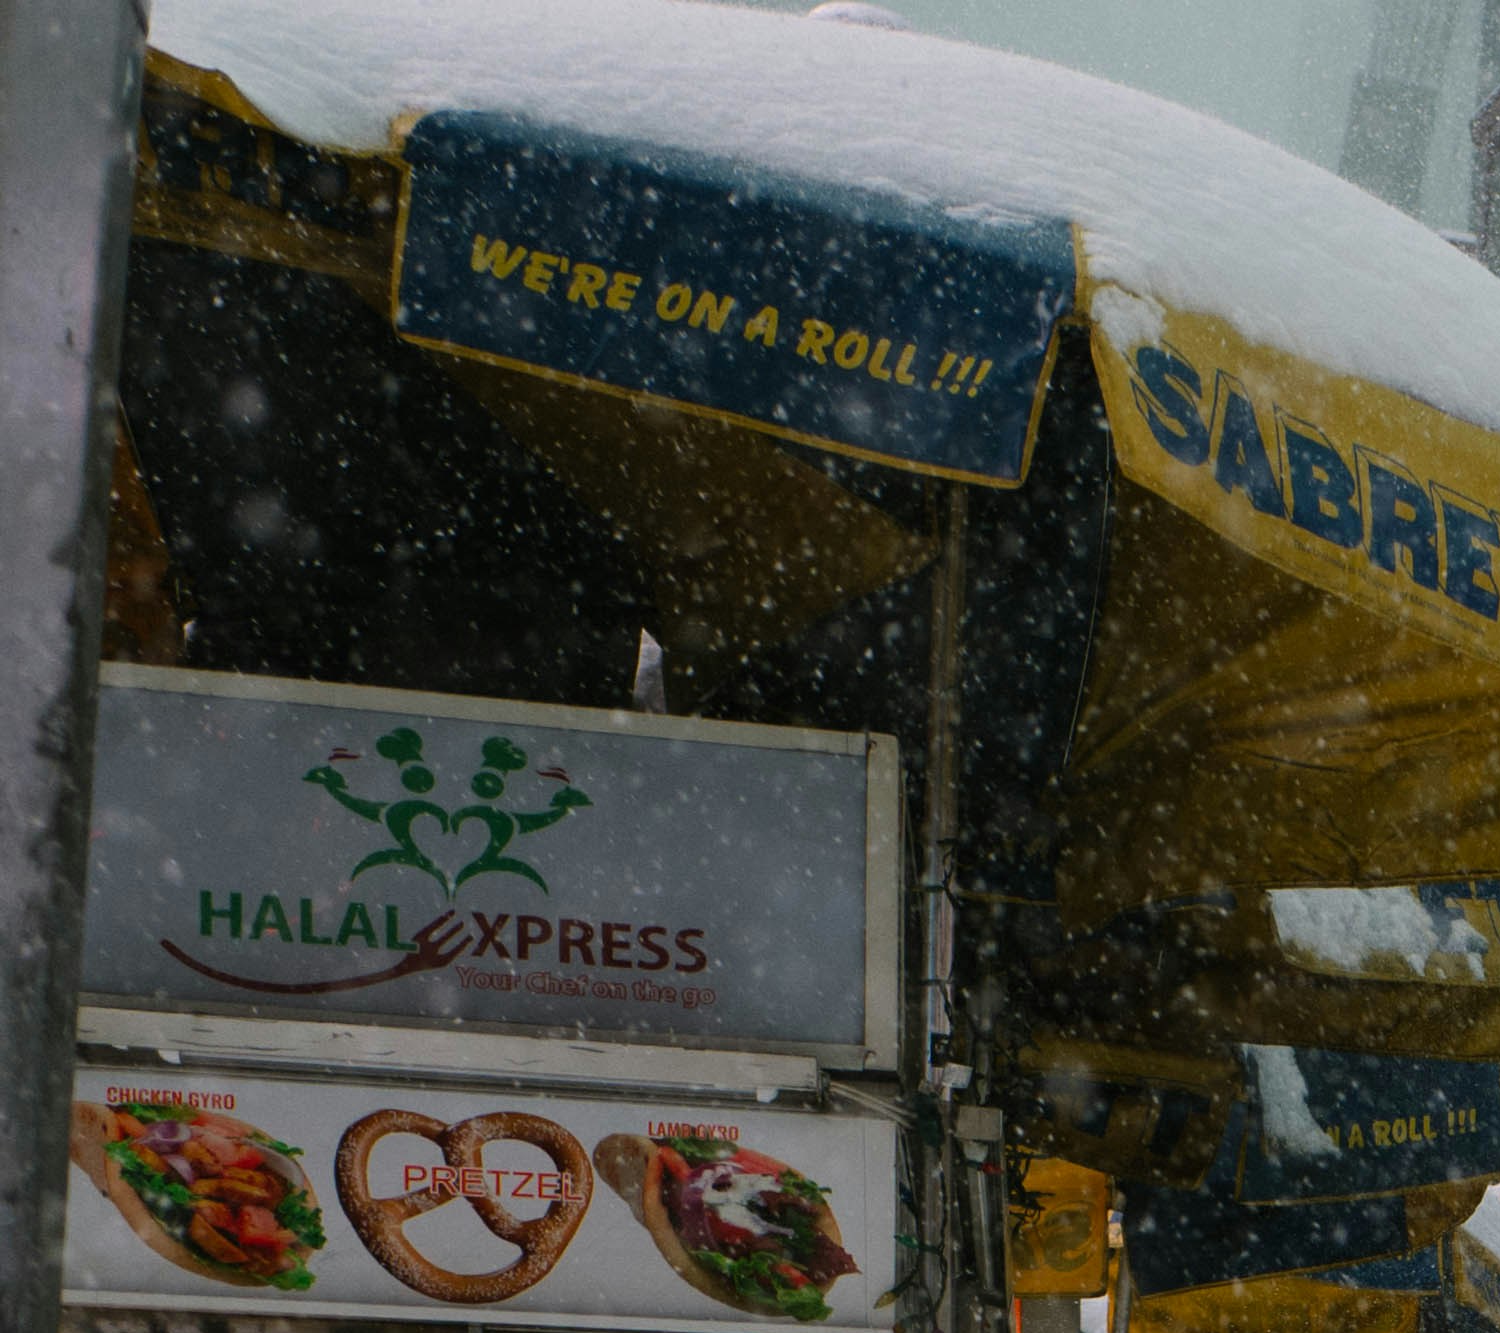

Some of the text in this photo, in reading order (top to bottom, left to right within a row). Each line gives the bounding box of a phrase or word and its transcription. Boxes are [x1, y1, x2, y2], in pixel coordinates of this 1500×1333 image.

[470, 233, 642, 312] WE'RE
[656, 283, 735, 335] ON
[743, 305, 780, 347] A
[796, 317, 917, 387] ROLL
[198, 888, 420, 954] HALAL
[455, 966, 715, 1010] Your Chef on the go
[105, 1086, 235, 1111] CHICKEN GYRO
[696, 1123, 739, 1142] GYRO
[1347, 1123, 1365, 1149] A
[1372, 1115, 1437, 1147] ROLL
[403, 1162, 583, 1202] PRETZEL
